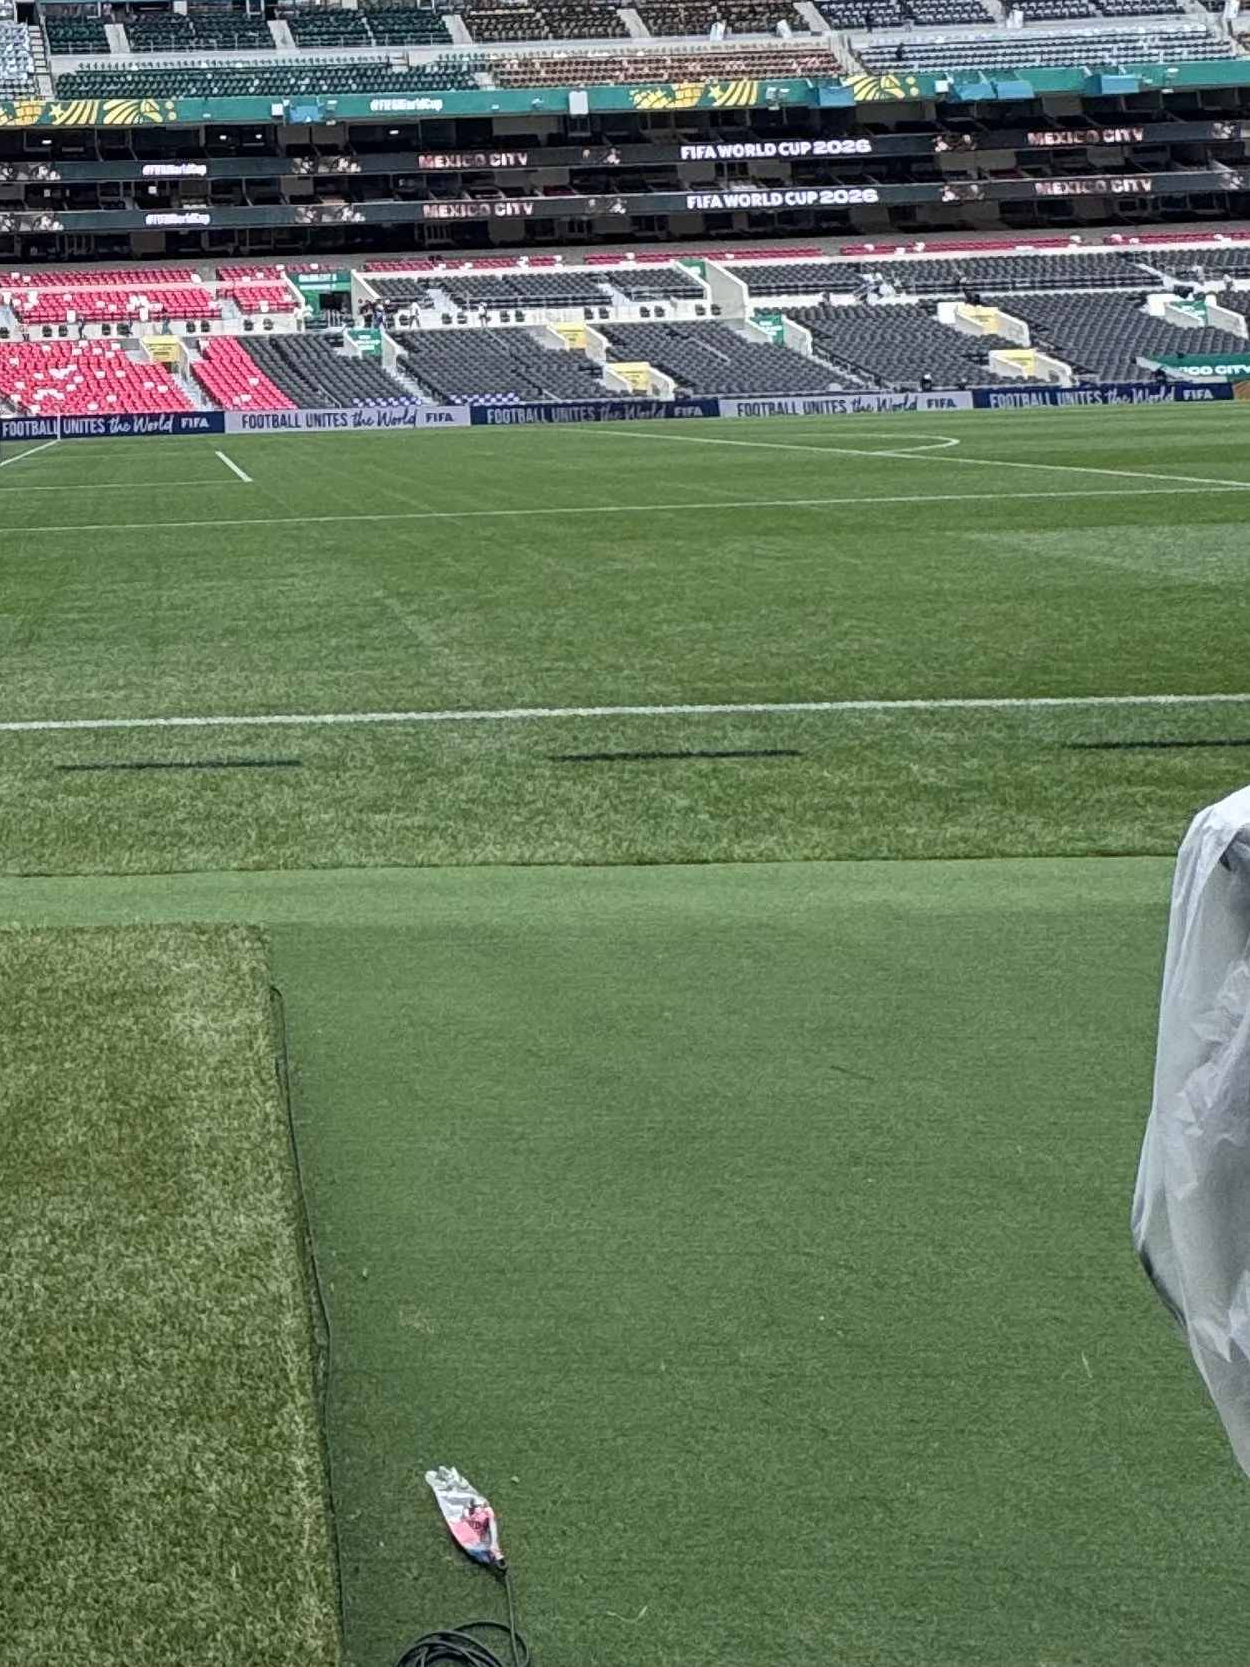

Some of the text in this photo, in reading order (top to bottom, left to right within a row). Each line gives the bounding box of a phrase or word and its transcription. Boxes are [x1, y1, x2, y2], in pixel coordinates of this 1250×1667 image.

[1027, 127, 1144, 146] MEXICO CITY
[418, 152, 528, 168] MEXICO CITY
[680, 139, 872, 160] FIFA WORLD CUP 2026
[1035, 178, 1152, 195] MEXICO CITY
[686, 189, 879, 209] FIFA WORLD CUP 2026
[422, 202, 534, 219] MEXICO CITY
[737, 393, 957, 417] FOOTBALL UNITES the World FIFA
[989, 386, 1214, 408] FOOTBALL UNITES the World FIFA
[241, 408, 454, 429] FOOTBALL UNITES the World FIFA
[487, 402, 702, 424] FOOTBALL UNITES the World FIFA
[2, 414, 210, 437] FOOTBALL UNITES the World FIFA
